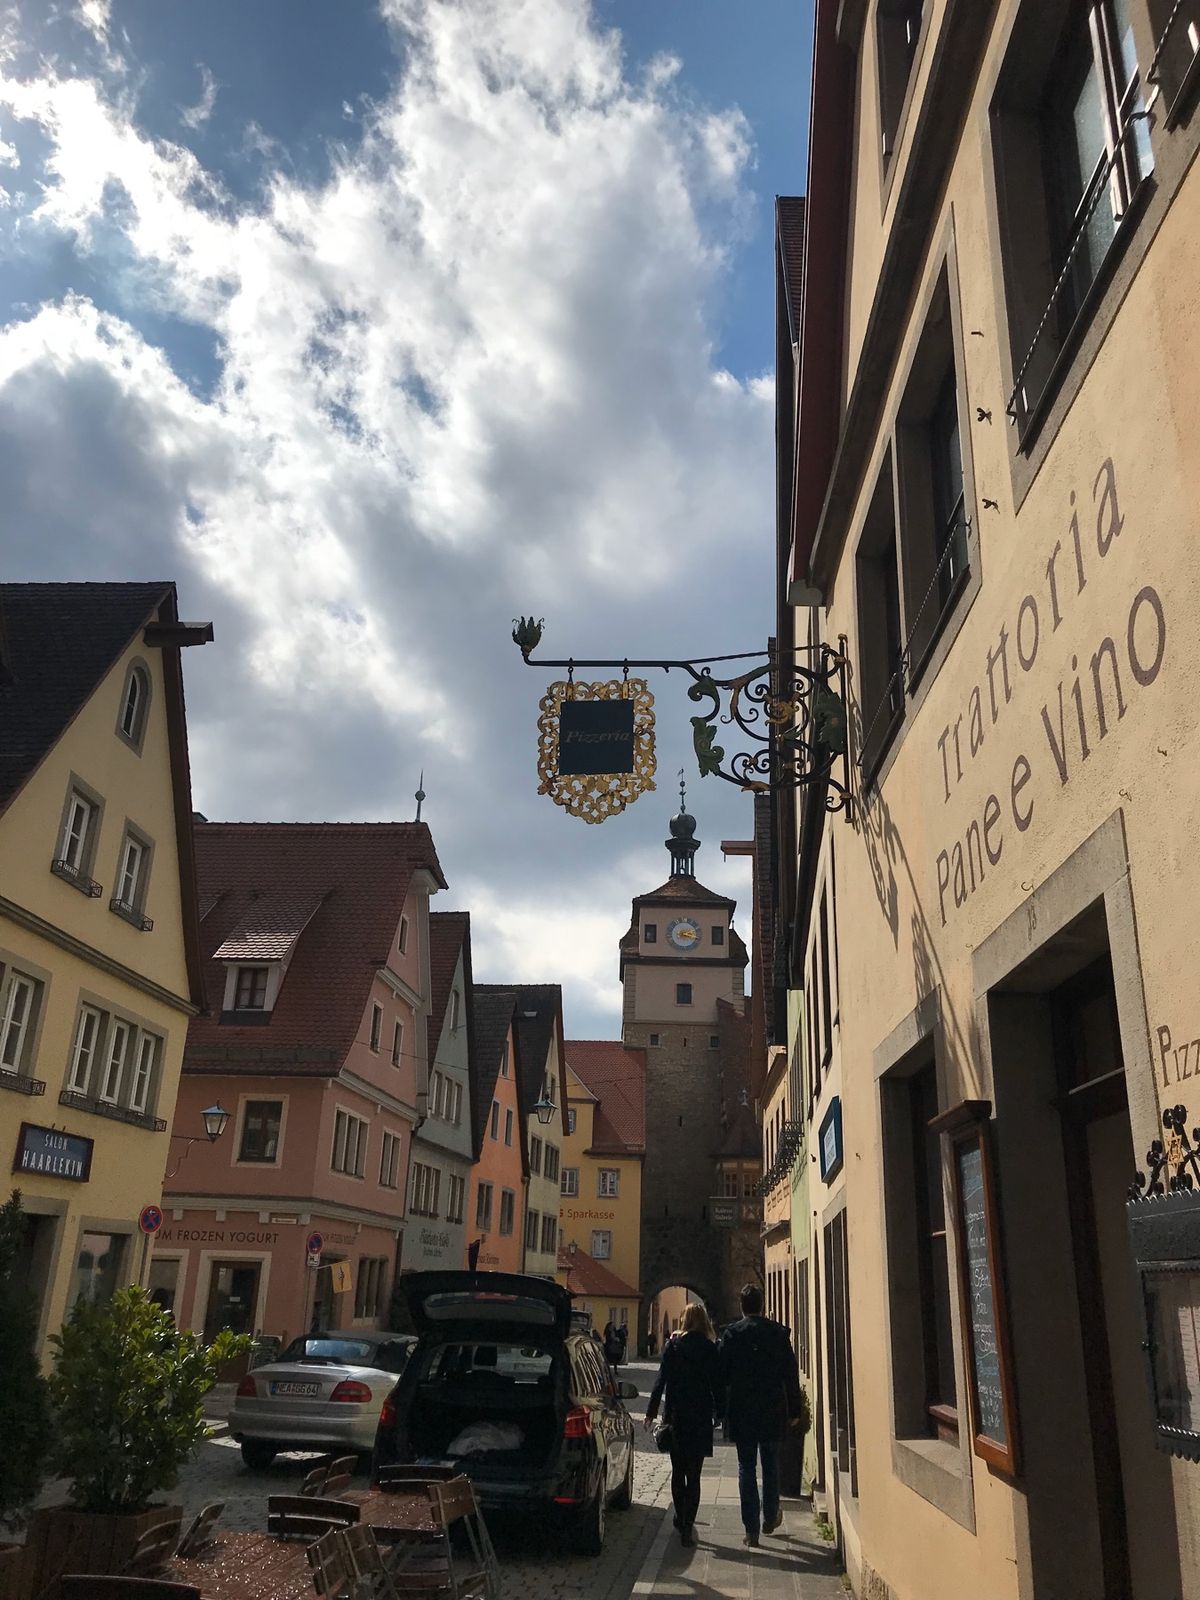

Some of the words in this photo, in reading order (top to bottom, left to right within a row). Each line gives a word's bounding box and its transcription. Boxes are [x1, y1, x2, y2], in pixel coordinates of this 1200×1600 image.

[937, 456, 1125, 804] Trattoria
[565, 728, 630, 744] Pizzeria
[936, 794, 1004, 928] Pane
[1011, 754, 1034, 832] e
[1040, 585, 1166, 787] Vino
[44, 1134, 68, 1151] SALON
[22, 1150, 82, 1177] HAARLEKIN
[567, 1208, 615, 1220] Sparkasse
[177, 1229, 225, 1241] FROZEN
[229, 1231, 280, 1244] YOGURT
